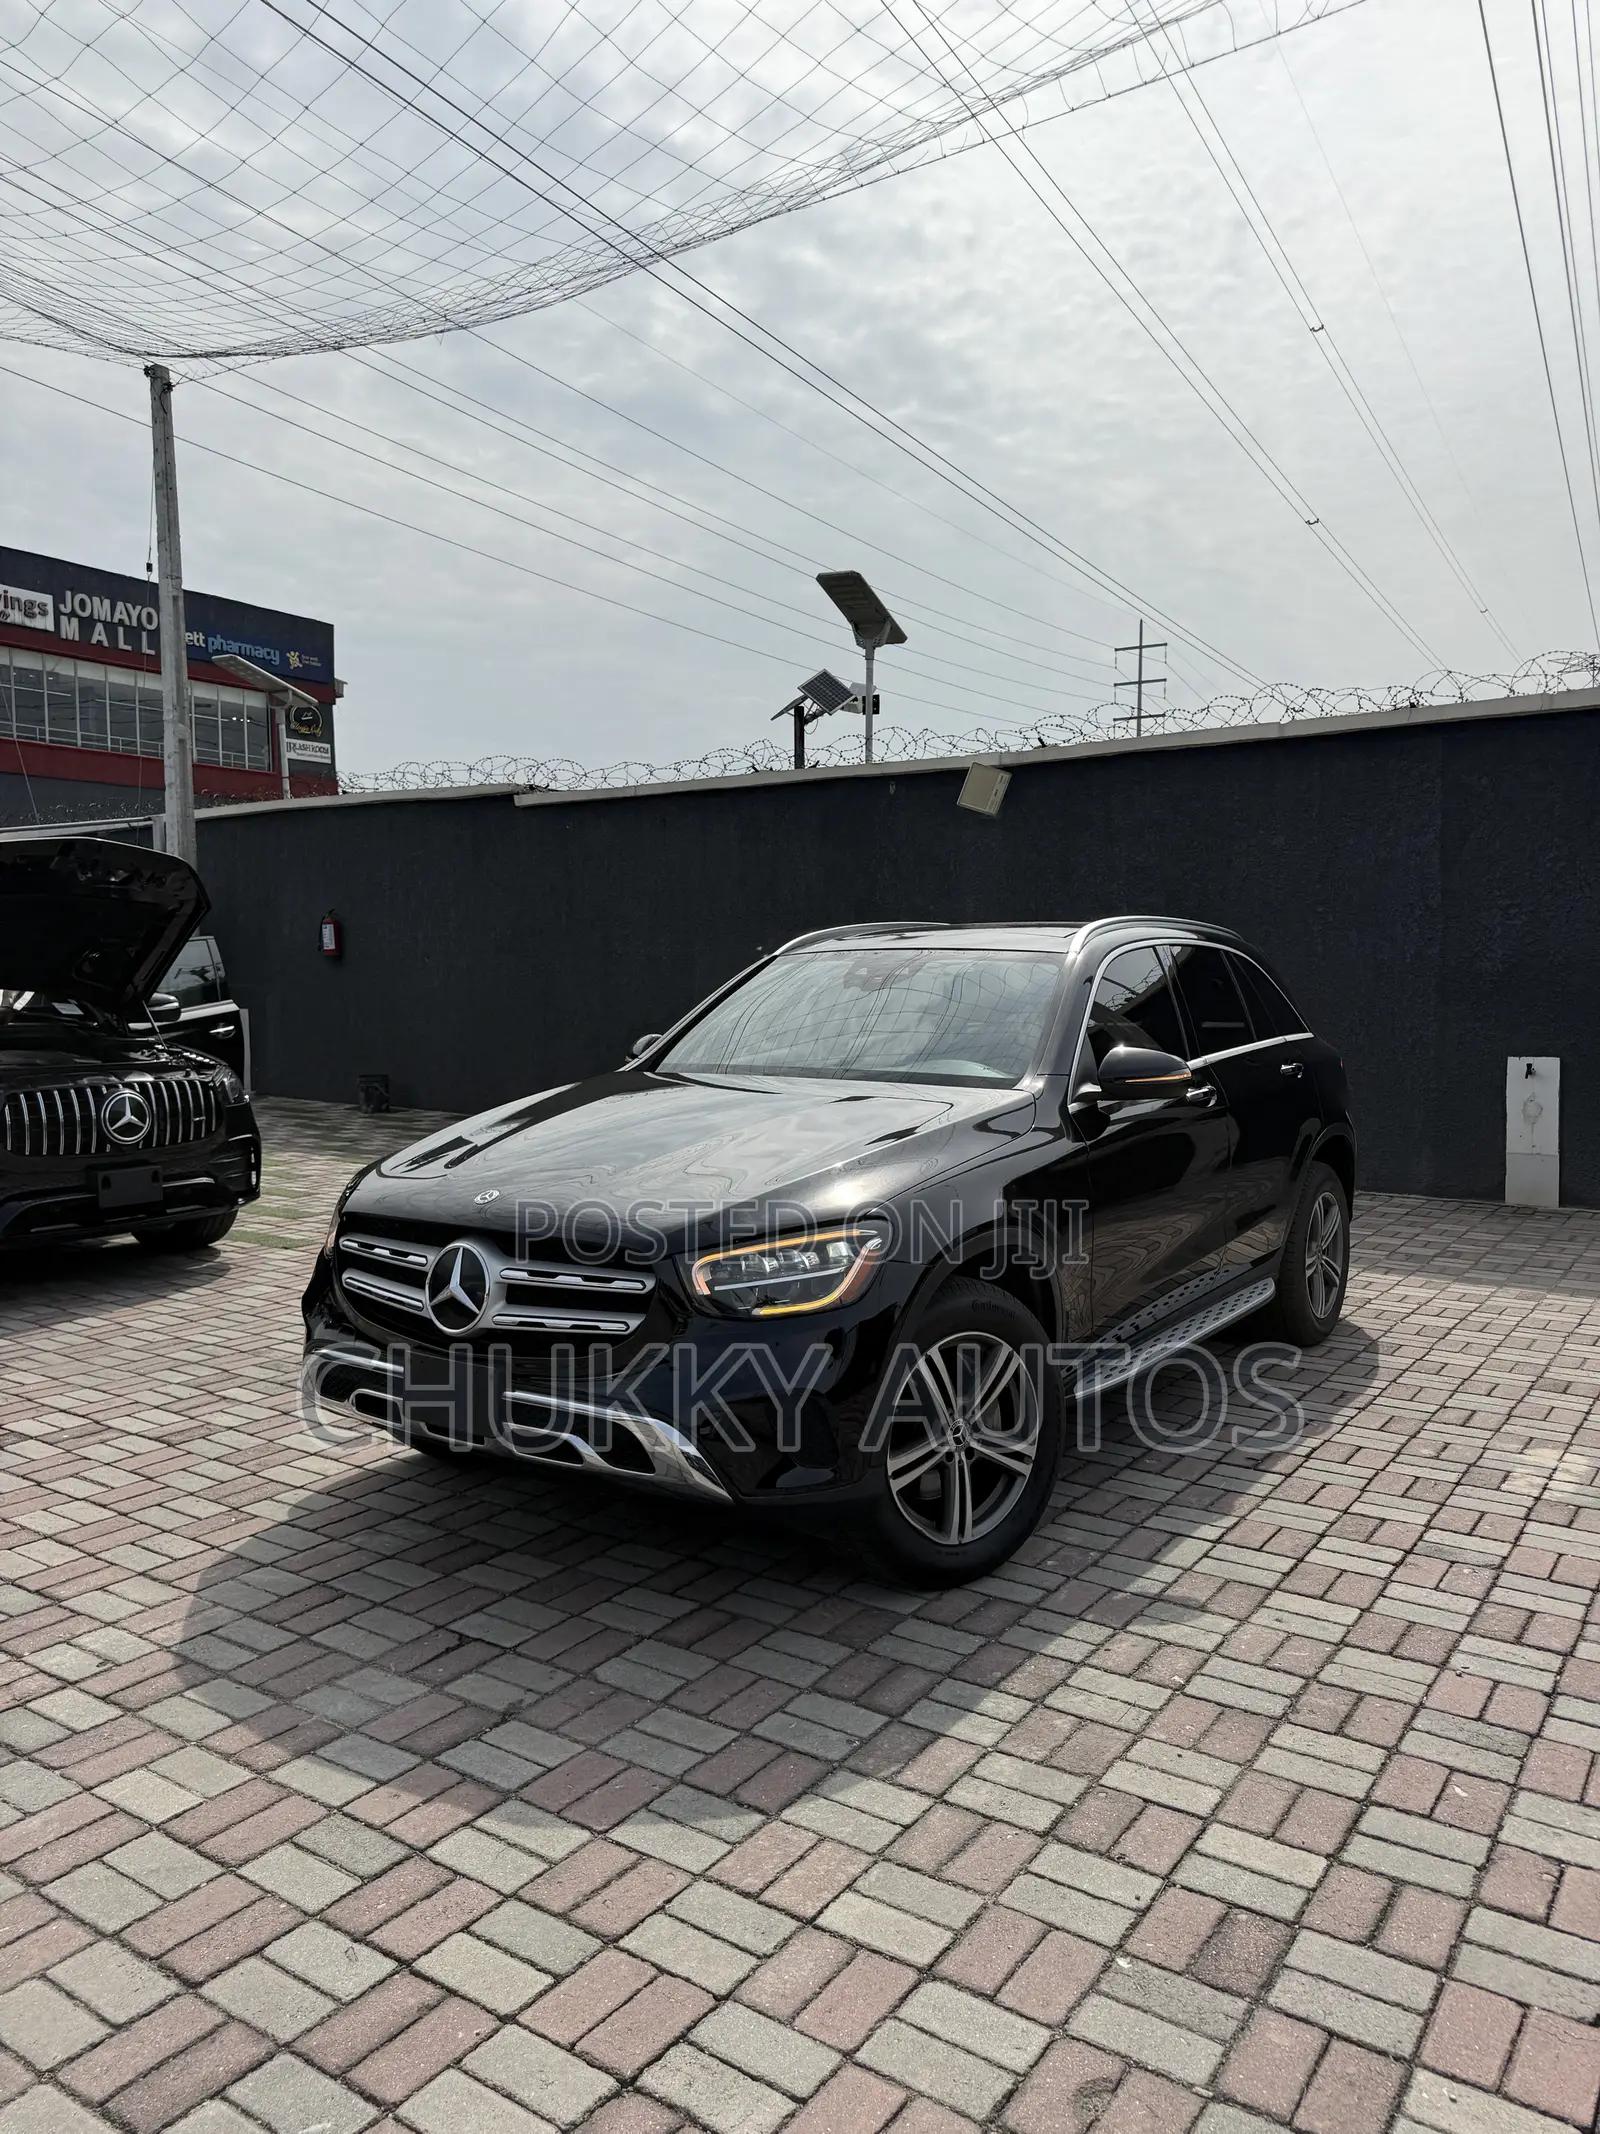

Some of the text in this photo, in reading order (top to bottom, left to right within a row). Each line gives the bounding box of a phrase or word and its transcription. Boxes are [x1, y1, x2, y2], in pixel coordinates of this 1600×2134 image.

[0, 589, 49, 618] ings
[58, 590, 159, 630] JOMAYO
[60, 615, 156, 655] MALL
[208, 634, 280, 665] pharmacy
[971, 1298, 1016, 1321] Continental
